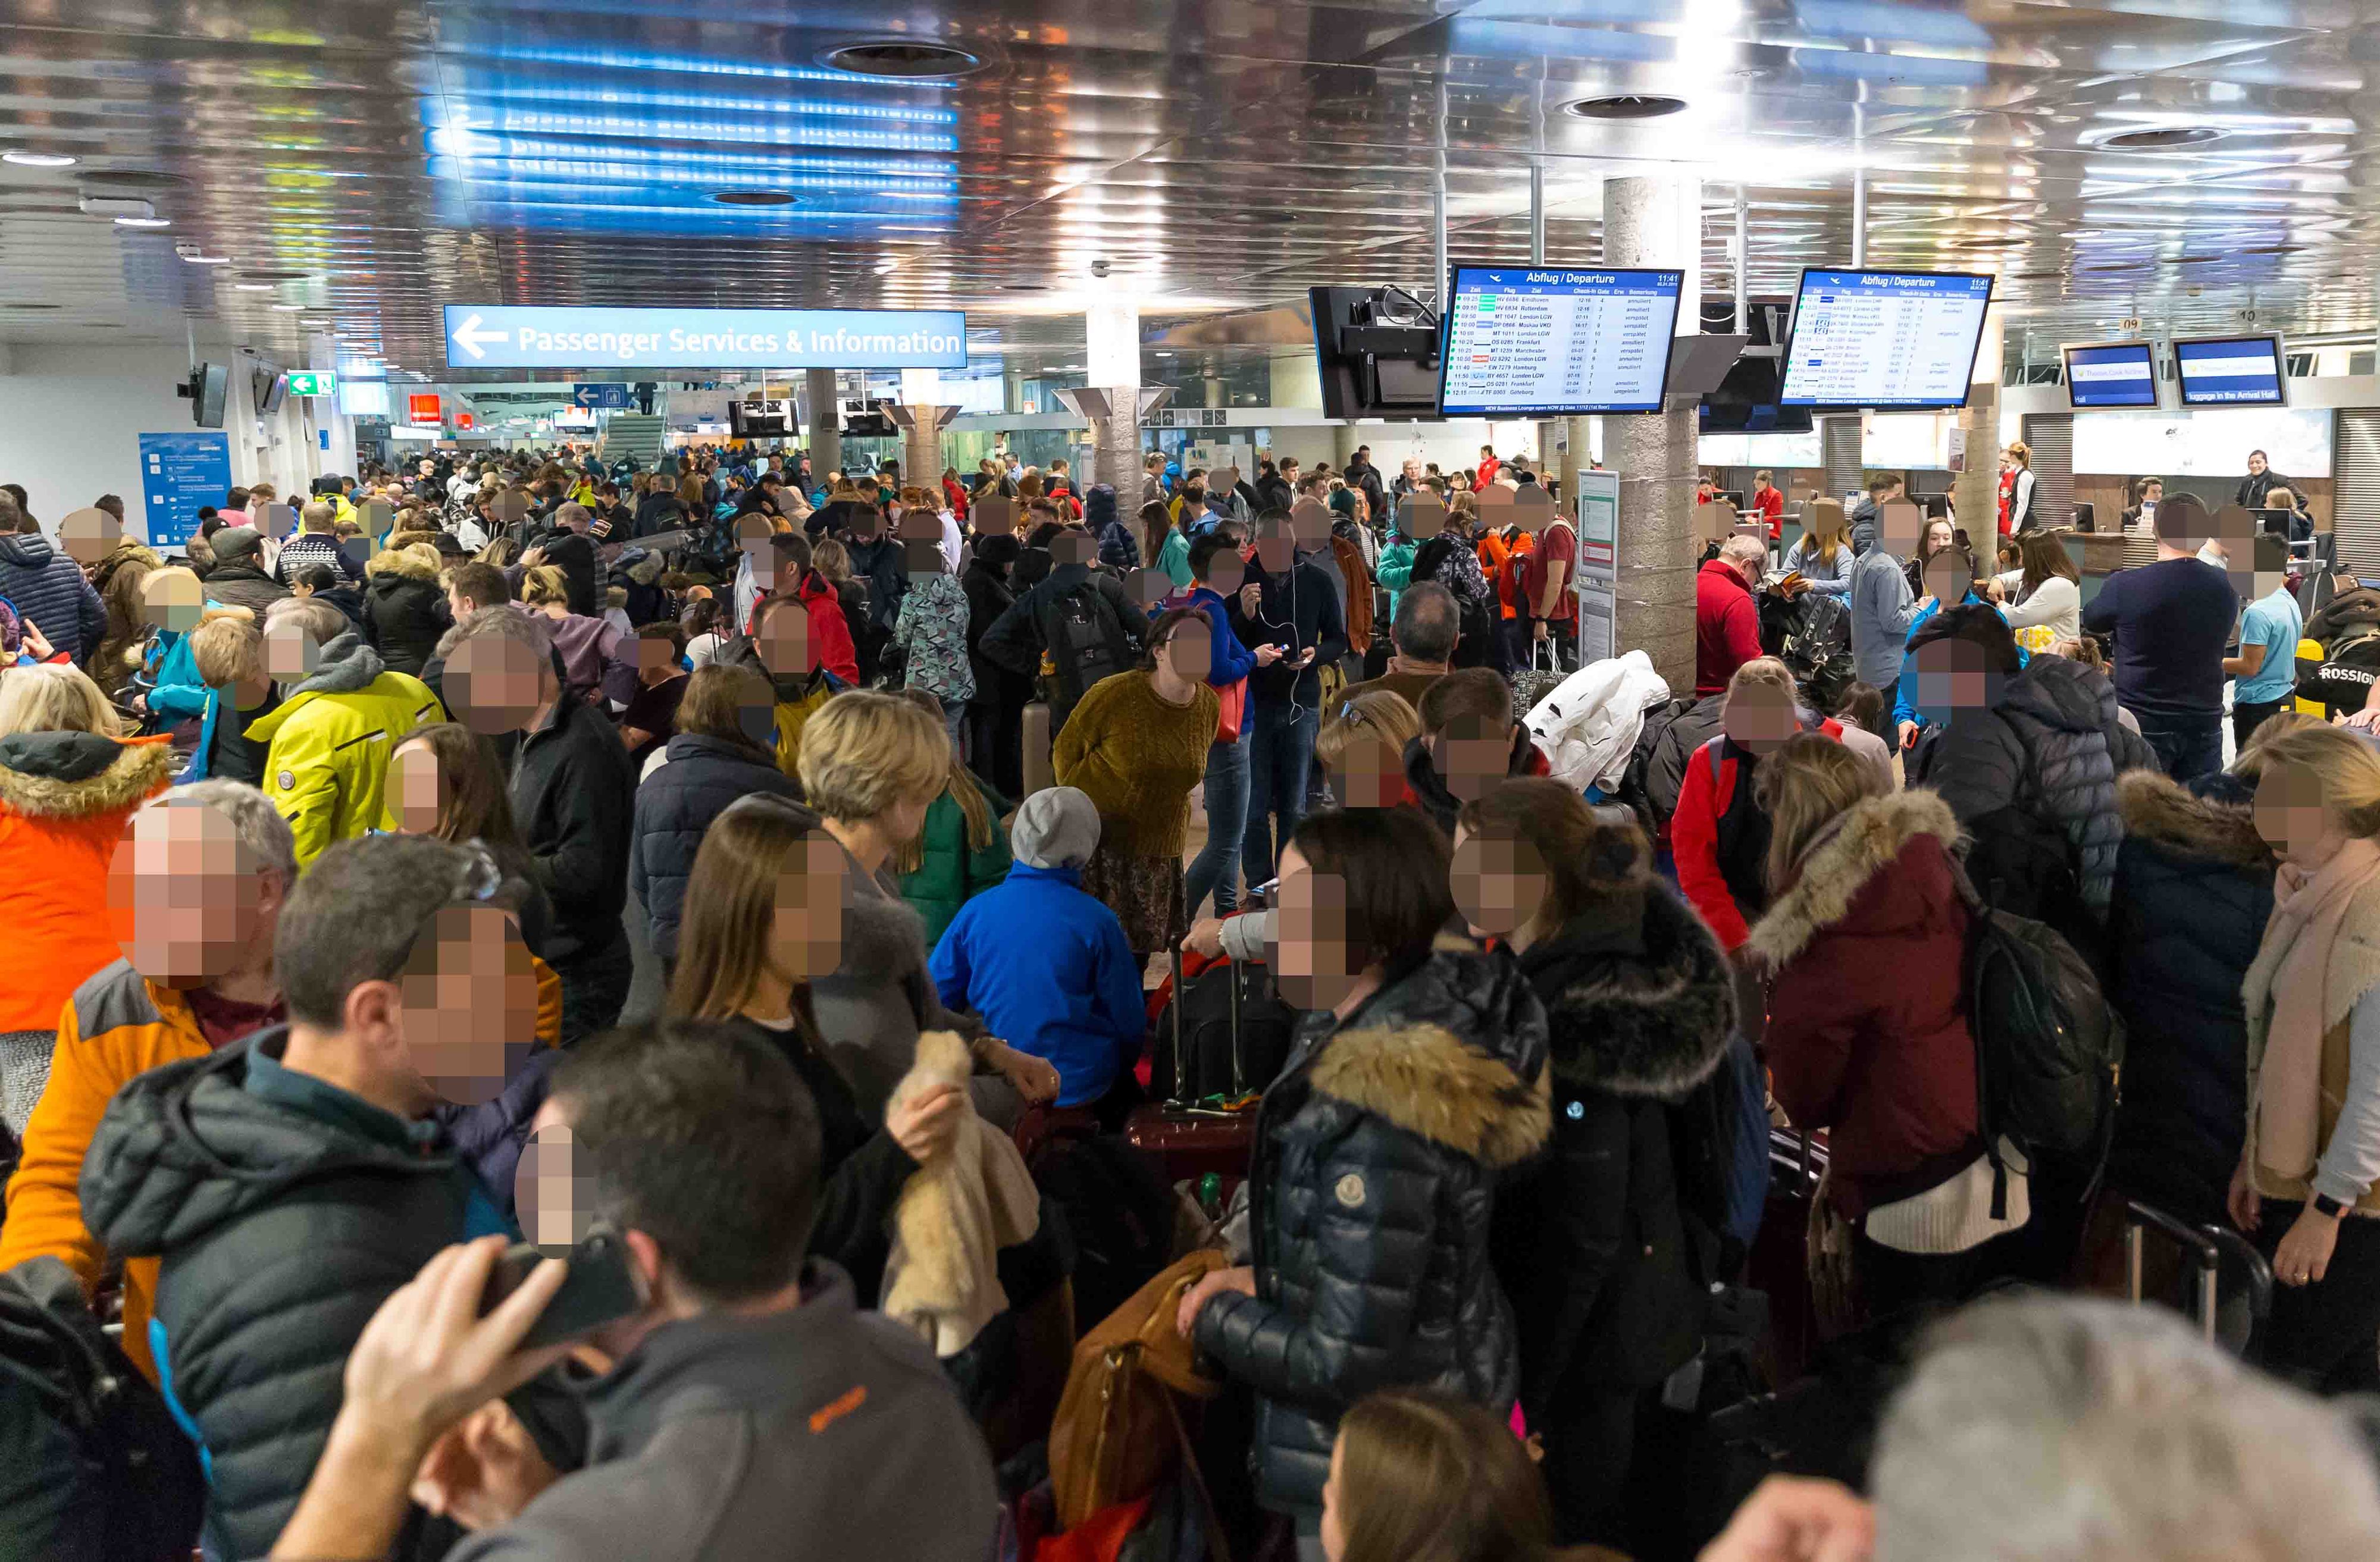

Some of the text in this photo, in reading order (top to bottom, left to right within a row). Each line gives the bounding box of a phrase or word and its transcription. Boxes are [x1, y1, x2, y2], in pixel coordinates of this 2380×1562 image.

[1527, 272, 1615, 284] Abflug / Departure
[1658, 274, 1678, 283] 11:41
[1861, 276, 1888, 287] Abflug
[1894, 277, 1935, 287] Departure
[2240, 310, 2255, 321] 10
[2124, 319, 2137, 329] 09
[518, 327, 960, 359] Passenger Services & Information
[2190, 393, 2216, 401] luggage
